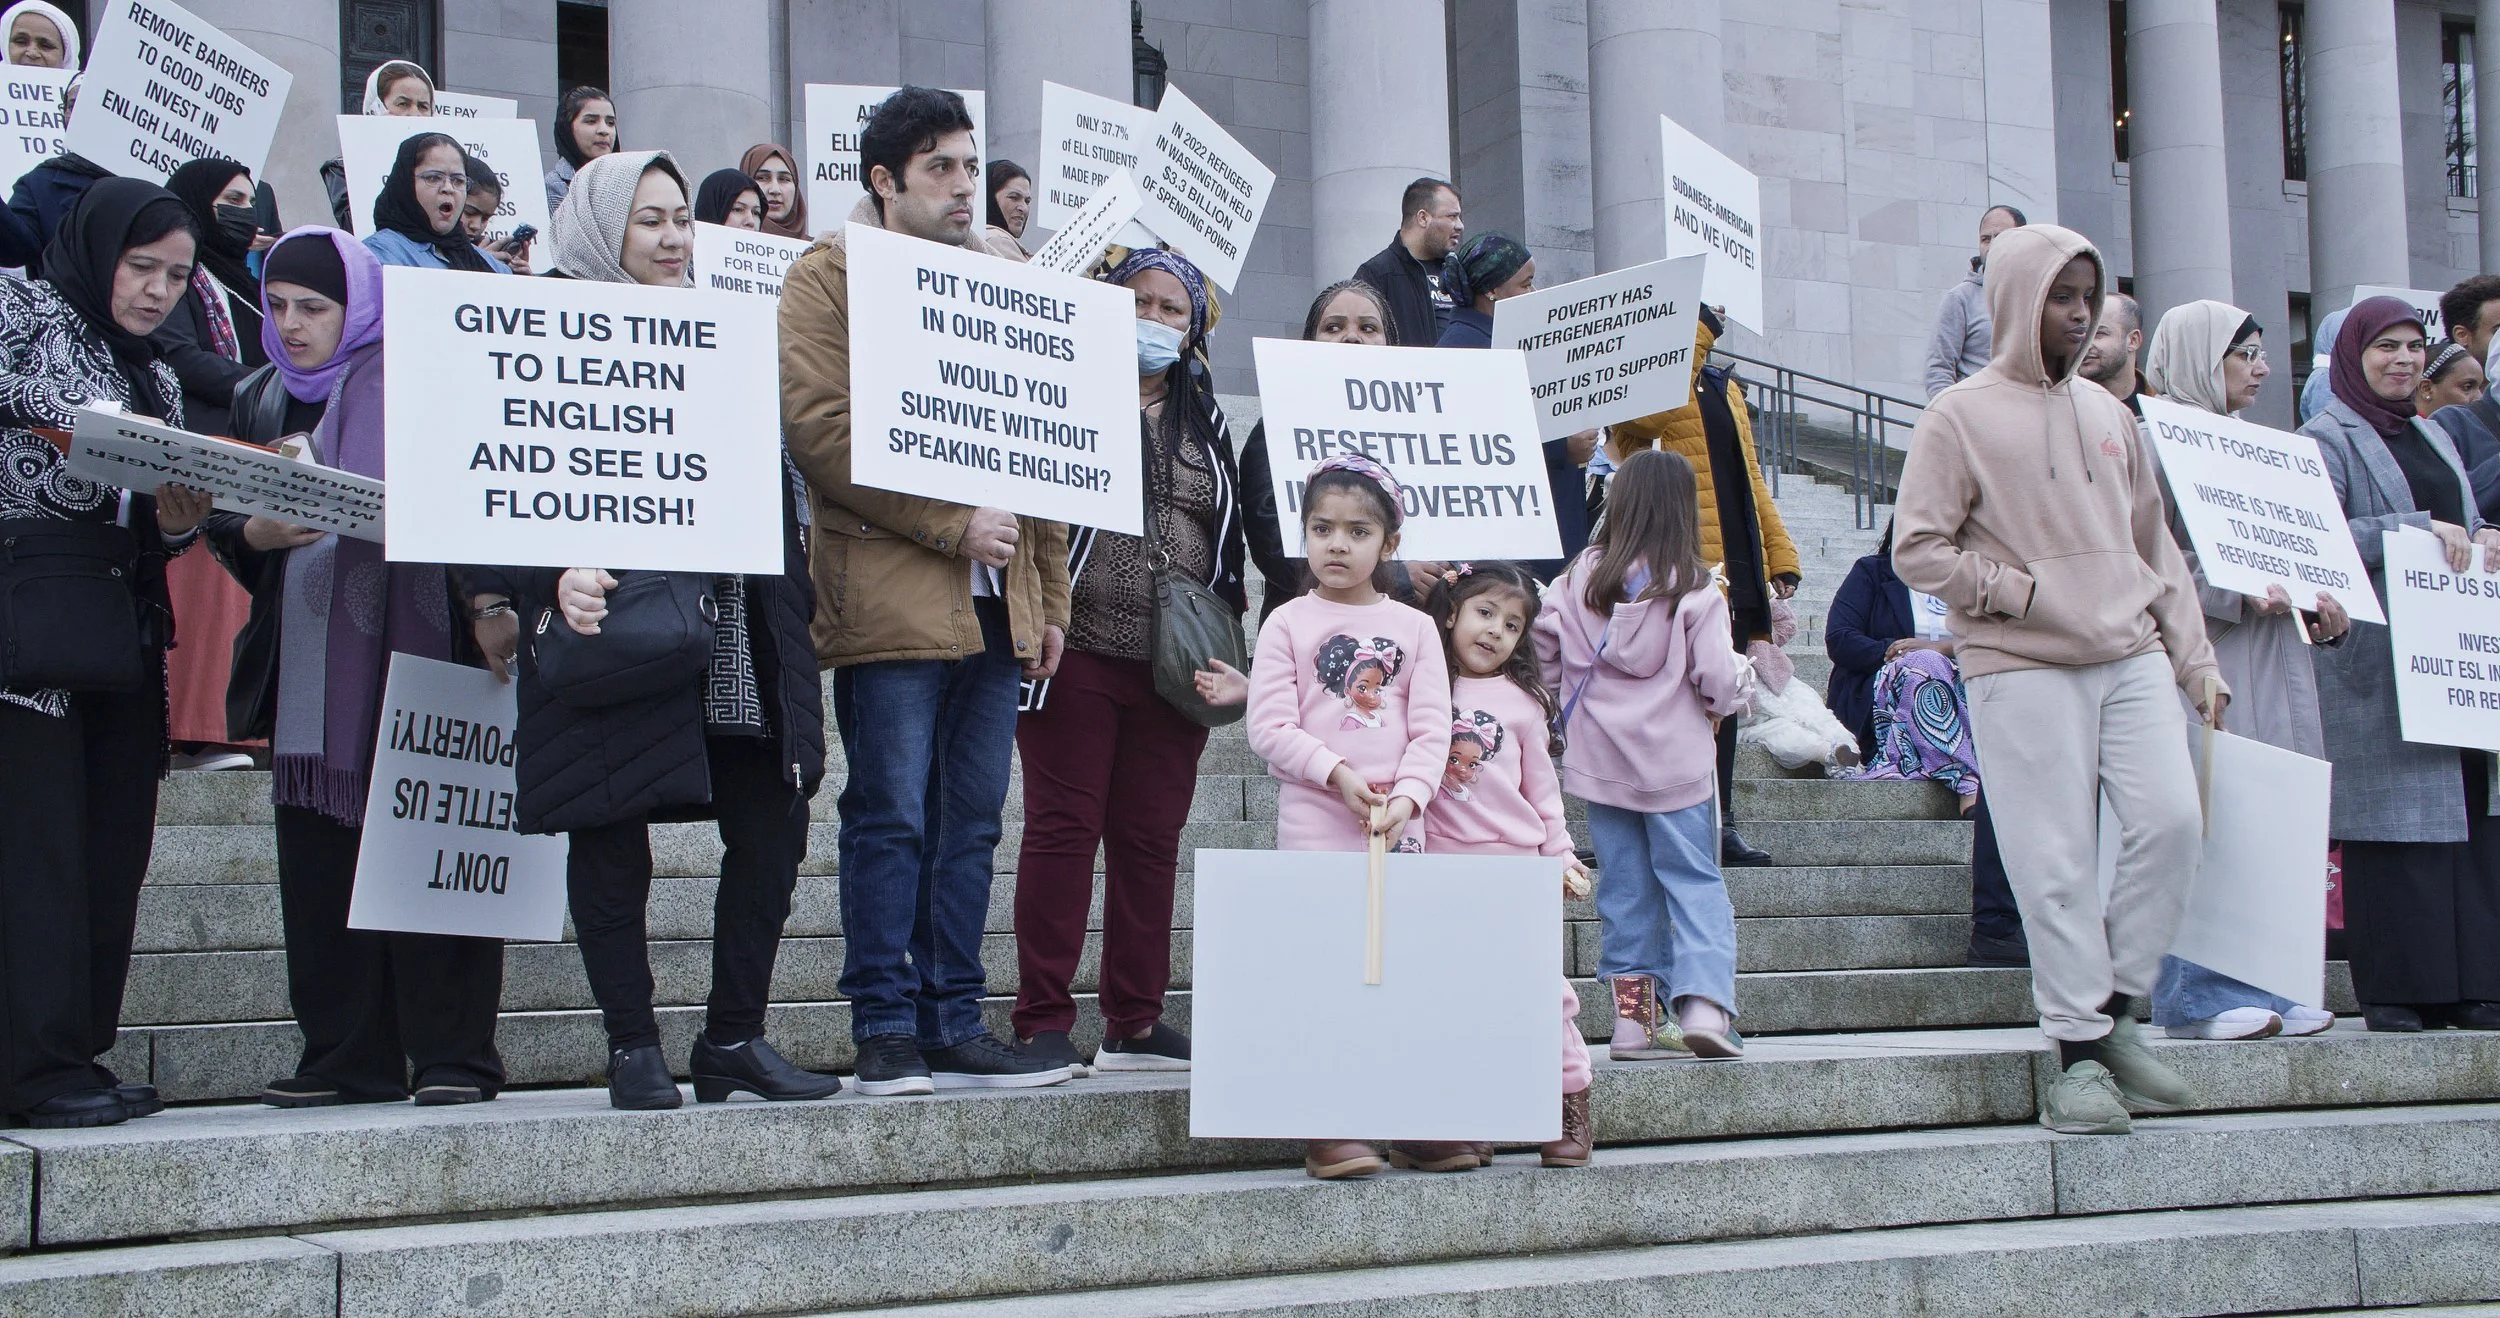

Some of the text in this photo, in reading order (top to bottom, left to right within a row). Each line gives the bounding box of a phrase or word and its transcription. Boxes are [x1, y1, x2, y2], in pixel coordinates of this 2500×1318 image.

[128, 1, 270, 97] REMOVE BARRIERS
[8, 82, 54, 102] GIVE
[137, 40, 245, 116] TO GOOD JOBS
[16, 110, 66, 129] LEAR
[102, 89, 160, 135] ENLIGH
[145, 79, 219, 134] INVEST IN
[454, 107, 478, 118] PAY
[20, 136, 46, 154] TO
[1076, 113, 1129, 141] ONLY 37.7%
[130, 139, 180, 178] CLASS
[1062, 139, 1138, 169] of ELL STUDENTS
[1172, 121, 1253, 198] IN 2022 REFUGEES
[1062, 165, 1089, 184] MADE
[1155, 134, 1253, 223] IN WASHINGTON HELD
[1050, 189, 1060, 204] IN
[1162, 165, 1233, 232] $3.3 BILLION
[1672, 175, 1754, 239] SUDANESE-AMERICAN
[1142, 175, 1237, 261] OF SPENDING POWER
[1673, 205, 1755, 270] AND WE VOTE!
[724, 257, 782, 277] FOR ELL
[735, 241, 803, 261] DROP OU
[711, 274, 782, 298] MORE THA
[916, 267, 1076, 325] PUT YOURSELF
[1547, 284, 1653, 324] POVERTY HAS
[454, 303, 717, 349] GIVE US TIME
[922, 306, 1075, 362] IN OUR SHOES
[1518, 301, 1678, 352] INTERGENERATIONAL
[1566, 335, 1626, 364] IMPACT
[1571, 372, 1591, 391] US
[1595, 366, 1614, 385] TO
[1618, 347, 1690, 378] SUPPORT
[488, 351, 685, 391] TO LEARN
[938, 359, 1067, 409] WOULD YOU
[1345, 378, 1444, 414] DON'T
[1552, 384, 1629, 417] OUR KIDS!
[503, 398, 675, 435] ENGLISH
[901, 391, 1099, 453] SURVIVE WITHOUT
[116, 428, 181, 447] JOB
[1293, 428, 1516, 466] RESETTLE US
[2157, 420, 2321, 478] DON'T FORGET US
[190, 445, 281, 475] WAGE
[469, 442, 708, 482] AND SEE US
[888, 428, 1111, 493] SPEAKING ENGLISH?
[163, 451, 384, 510] OFFERED ME A
[236, 495, 257, 505] A
[263, 502, 341, 526] HAVE
[336, 505, 377, 522] MY
[485, 488, 696, 527] FLOURISH!
[1402, 485, 1541, 518] OVERTY!
[2193, 482, 2330, 532] WHERE IS THE BILL
[2227, 518, 2318, 556] TO ADDRESS
[2216, 542, 2351, 591] REFUGEES' NEEDS?
[2405, 569, 2450, 592] HELP
[2455, 576, 2479, 596] US
[2458, 632, 2500, 654] INVES
[2411, 655, 2454, 677] ADULT
[2459, 661, 2485, 681] ESL
[2448, 687, 2476, 708] FOR
[390, 709, 518, 768] POVERTY!
[392, 777, 519, 833] ETTLE US
[427, 849, 510, 895] DON'T
